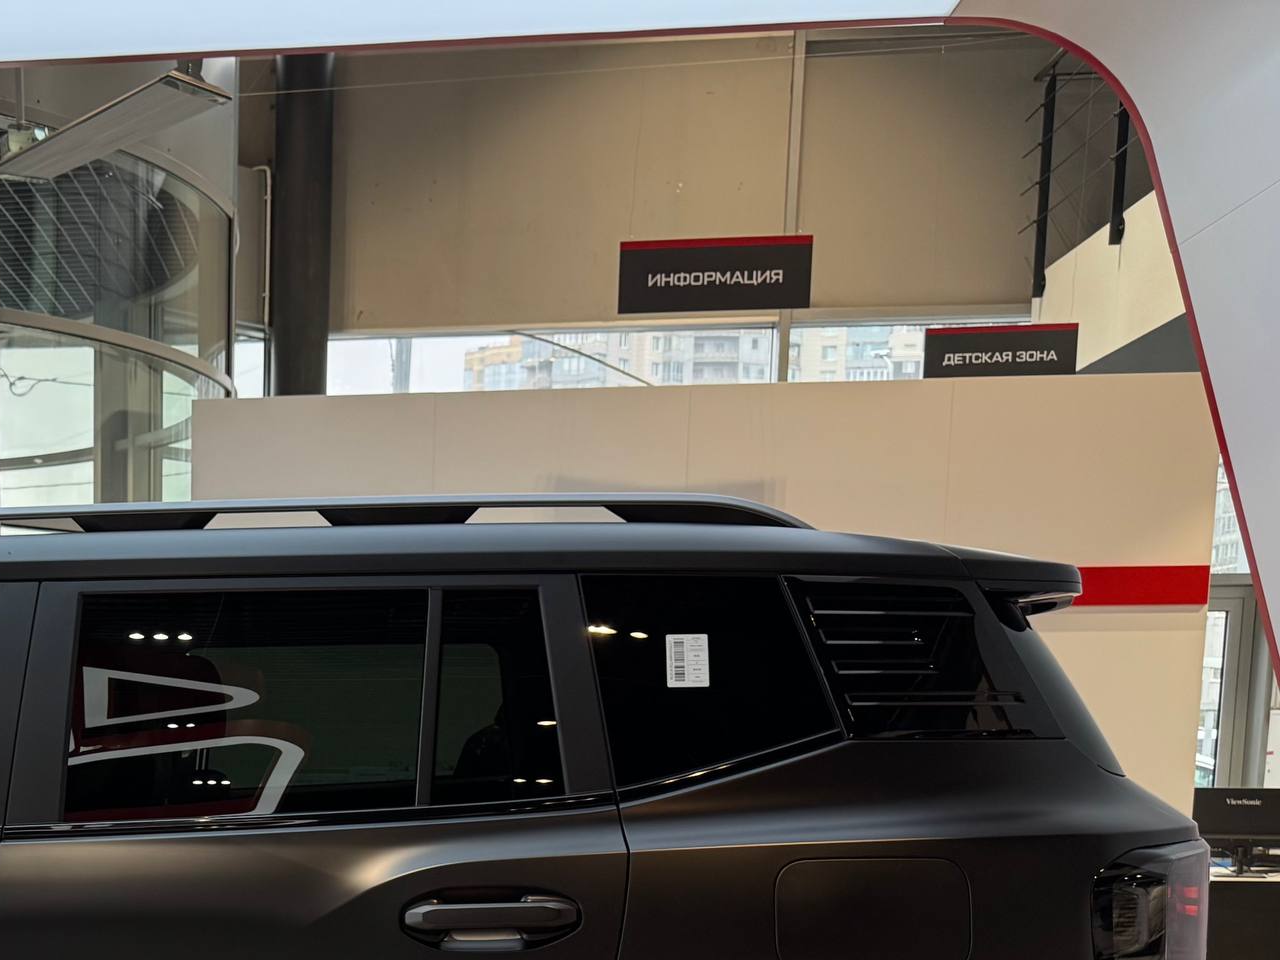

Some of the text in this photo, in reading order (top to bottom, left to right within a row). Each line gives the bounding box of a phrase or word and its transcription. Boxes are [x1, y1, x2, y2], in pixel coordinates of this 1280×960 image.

[647, 269, 784, 288] ИНФОРМАЦИЯ
[942, 350, 1058, 367] ДЕТСКАЯ ЗОНА
[1225, 797, 1262, 806] ViewSonic
